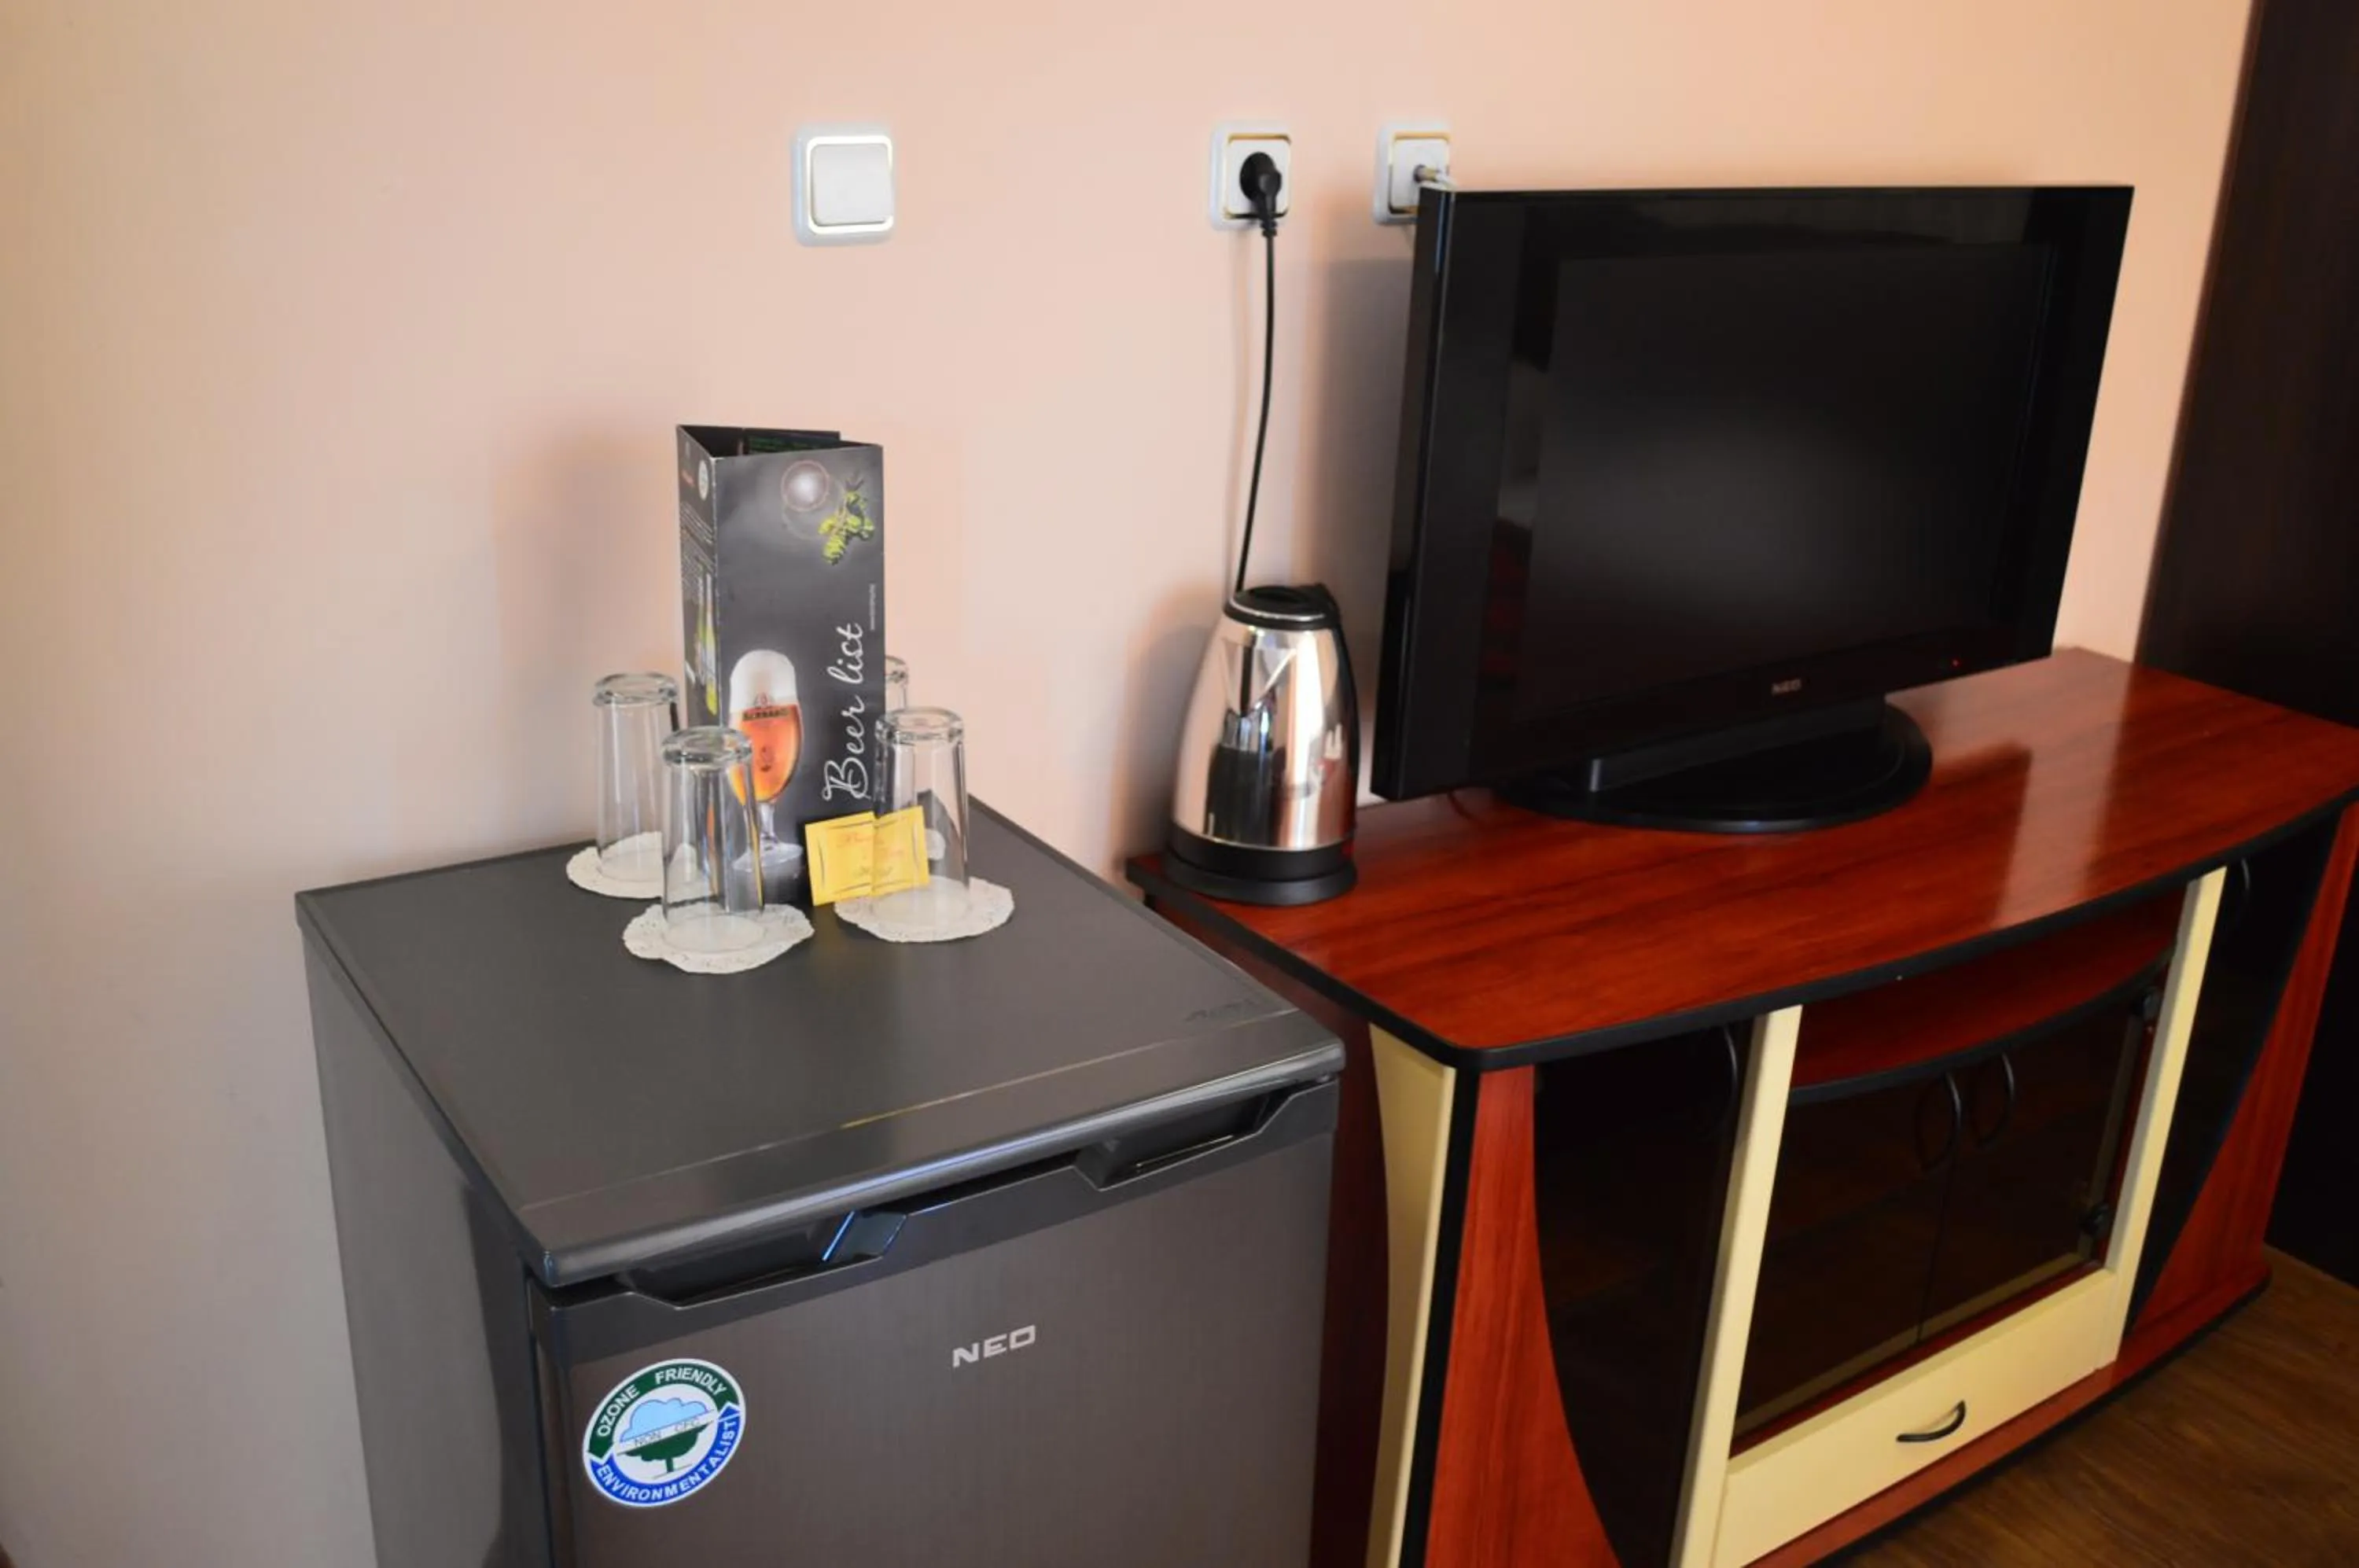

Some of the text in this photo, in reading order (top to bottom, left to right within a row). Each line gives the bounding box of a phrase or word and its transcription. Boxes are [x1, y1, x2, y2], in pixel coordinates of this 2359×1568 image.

[827, 622, 863, 684] list
[822, 694, 871, 801] Beer
[952, 1324, 1036, 1368] NEO
[596, 1367, 727, 1437] OZONE FRIENDLY
[596, 1419, 737, 1501] ENVIRONMENTALIST
